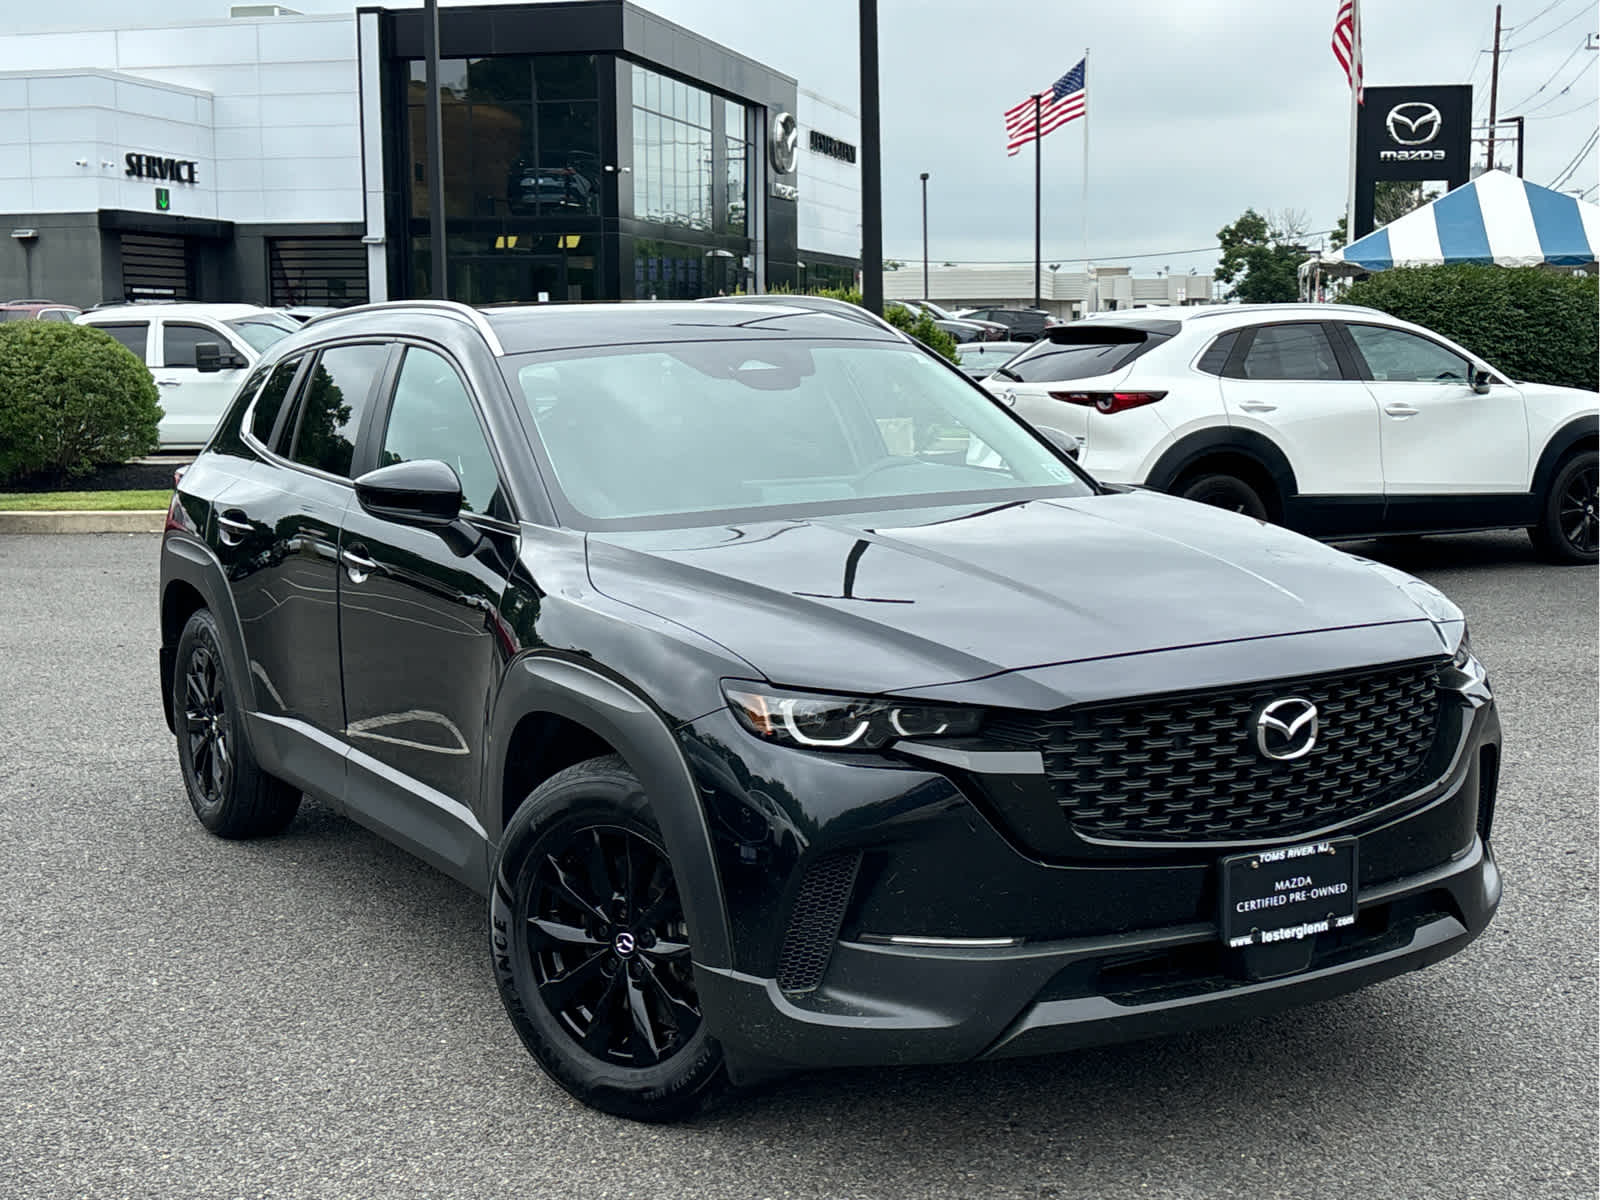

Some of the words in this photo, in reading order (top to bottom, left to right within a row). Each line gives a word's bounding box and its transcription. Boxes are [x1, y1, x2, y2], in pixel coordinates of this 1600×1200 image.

[1380, 150, 1446, 161] mazda
[125, 152, 200, 184] SERVICE
[1260, 850, 1286, 863] TOMS
[1317, 842, 1329, 853] NJ
[1274, 876, 1312, 891] MAZDA
[1236, 895, 1287, 912] CERTIFIED
[1289, 883, 1348, 903] PRE-OWNED
[1261, 921, 1328, 943] lesterglenn
